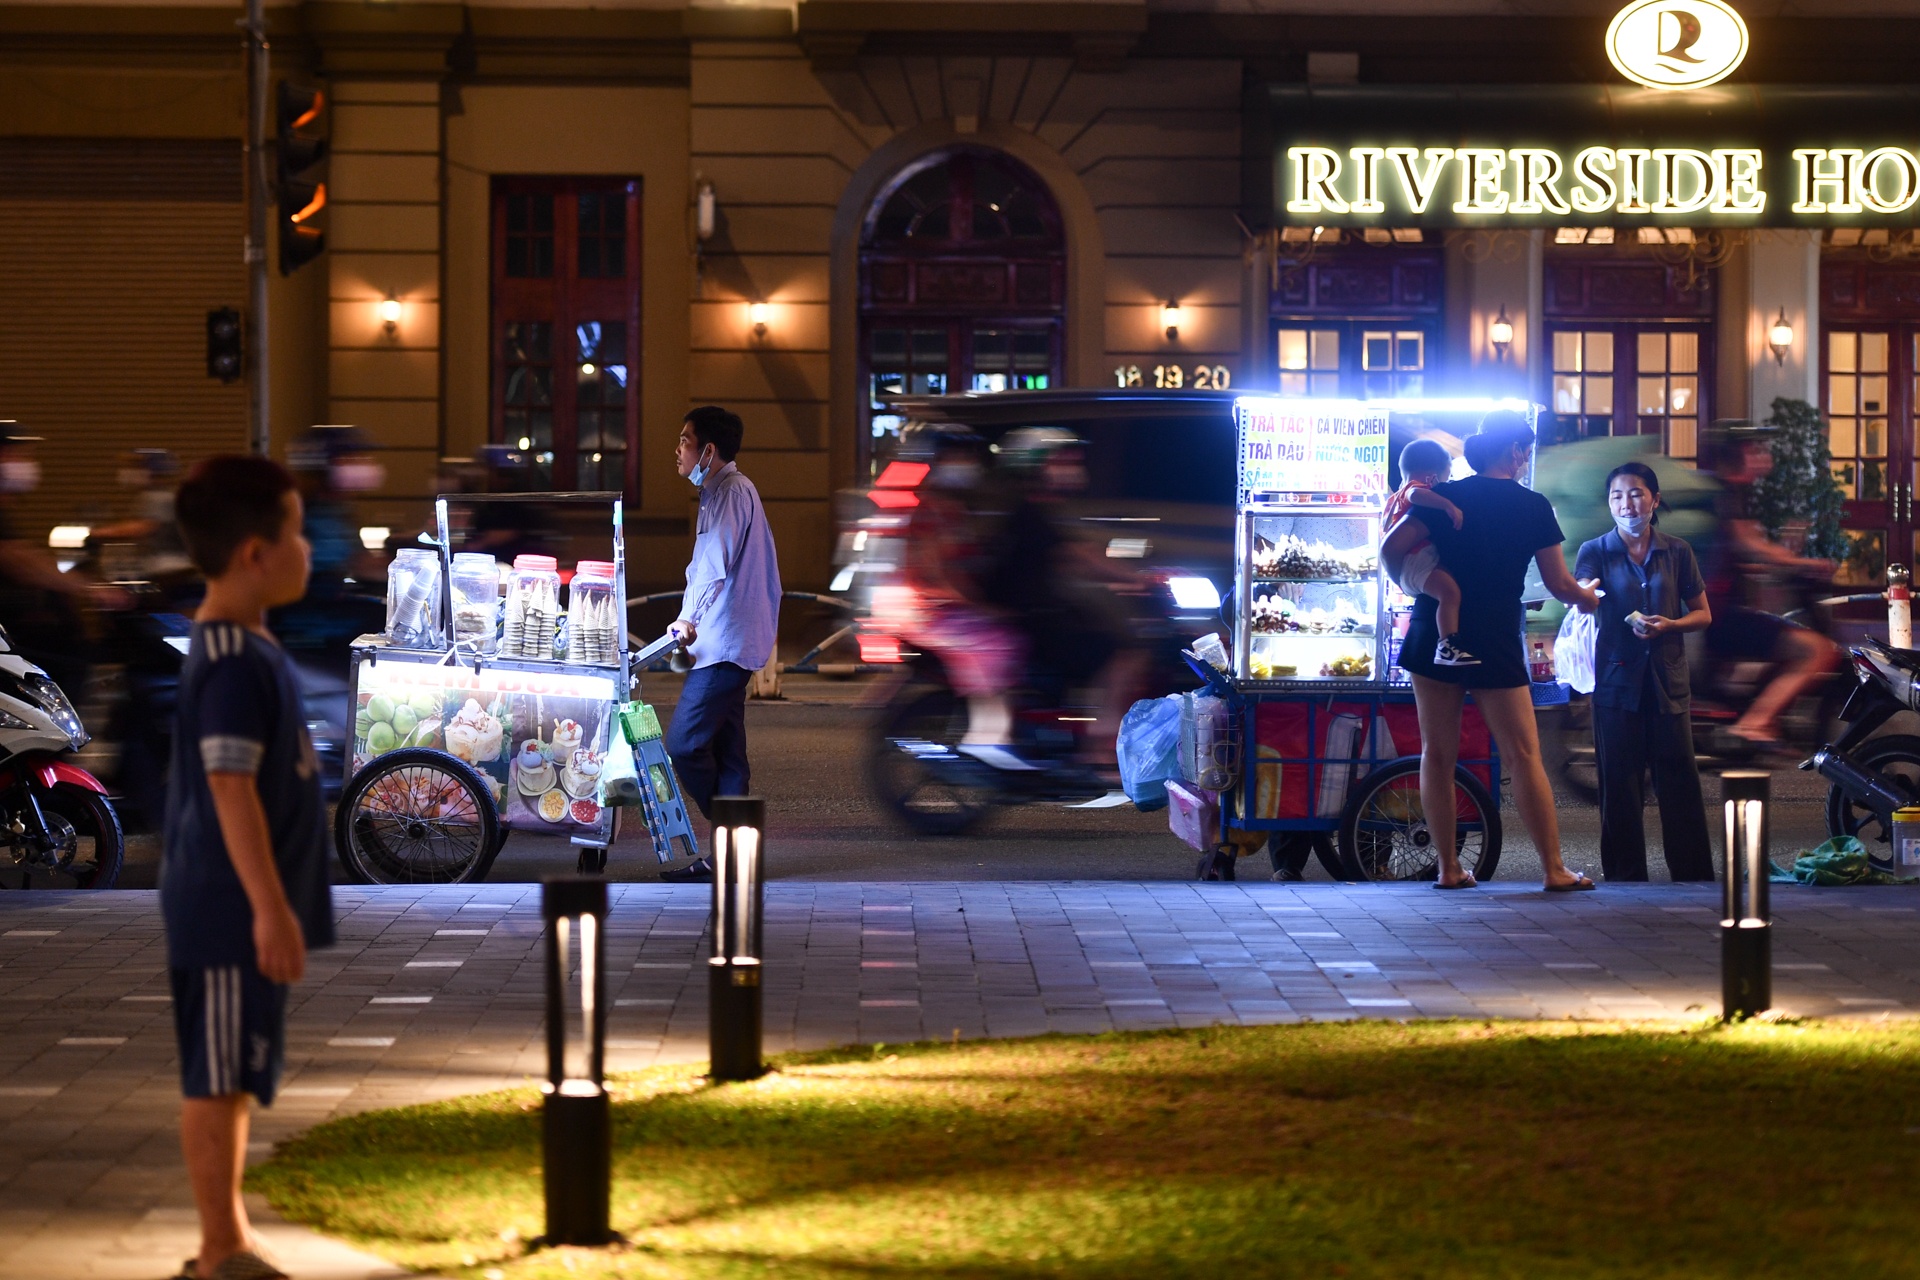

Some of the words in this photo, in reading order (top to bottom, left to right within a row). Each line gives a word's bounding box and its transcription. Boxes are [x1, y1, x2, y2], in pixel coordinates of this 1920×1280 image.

[1286, 146, 1767, 215] RIVERSIDE
[1792, 146, 1920, 214] HO
[1248, 439, 1273, 460] TRÀ
[1354, 445, 1386, 467] NGỌT
